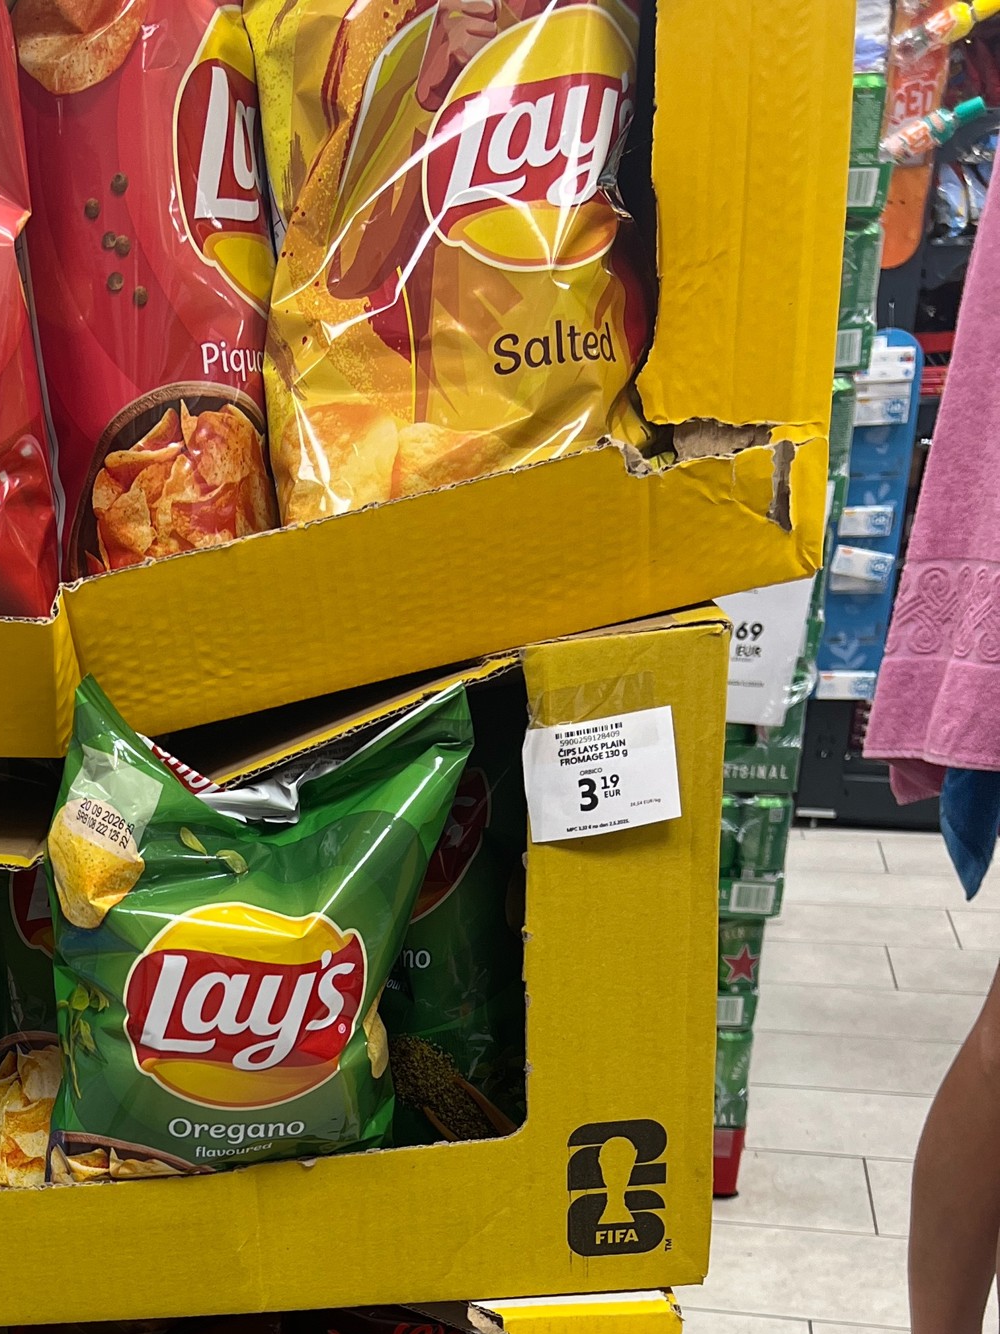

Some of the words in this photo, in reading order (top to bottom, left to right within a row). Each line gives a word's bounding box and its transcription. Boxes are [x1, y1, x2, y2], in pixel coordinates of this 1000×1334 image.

[492, 321, 616, 376] Salted
[200, 343, 264, 382] Piqu
[736, 622, 763, 641] 69
[736, 645, 762, 657] EUR
[558, 747, 576, 758] ČIPS
[578, 744, 599, 755] LAYS
[601, 739, 626, 750] PLAIN
[560, 751, 604, 766] FROMAGE
[605, 750, 620, 759] 130
[623, 749, 628, 758] g
[580, 768, 603, 776] ORBICO
[601, 774, 620, 790] 19
[578, 778, 599, 812] 3
[604, 789, 621, 798] EUR
[80, 797, 91, 811] 20
[91, 804, 103, 818] 09
[102, 810, 126, 830] 2026
[140, 949, 356, 1071] Lay's
[169, 1117, 305, 1143] Oregano
[195, 1142, 272, 1160] flavoured
[595, 1229, 639, 1244] FIFA
